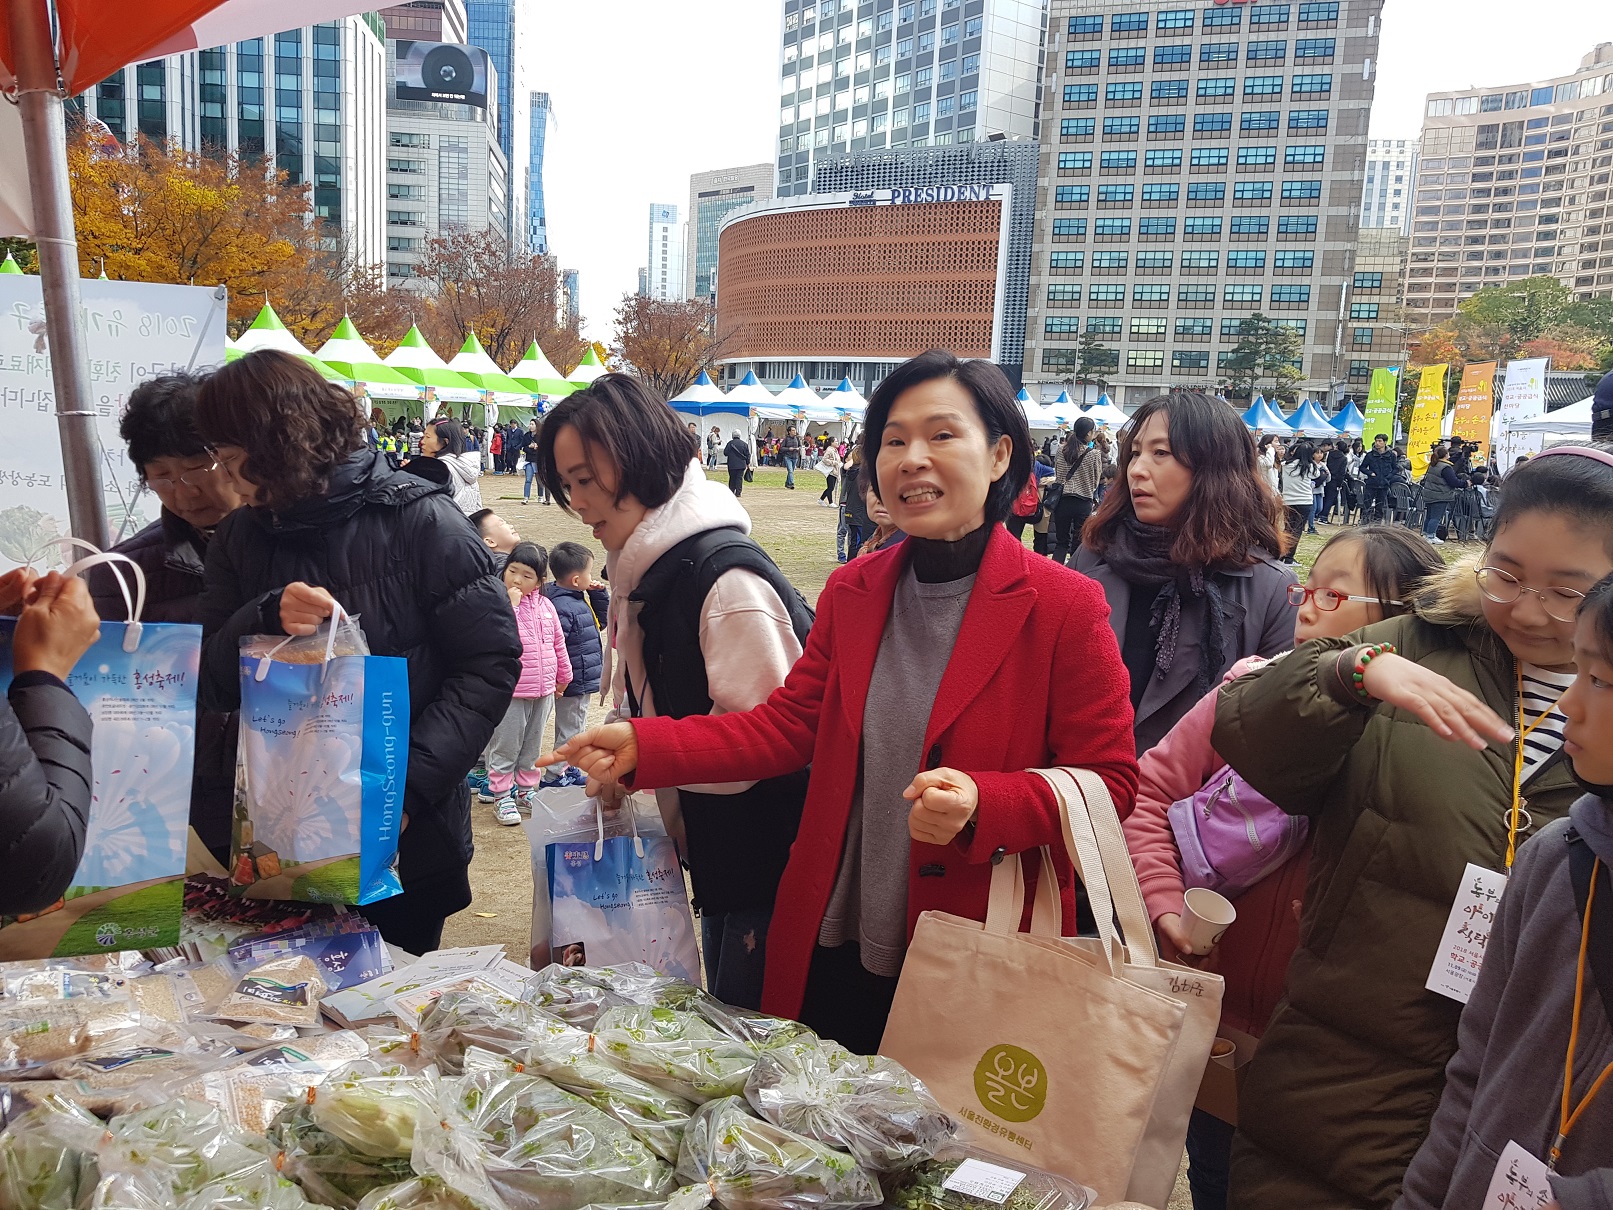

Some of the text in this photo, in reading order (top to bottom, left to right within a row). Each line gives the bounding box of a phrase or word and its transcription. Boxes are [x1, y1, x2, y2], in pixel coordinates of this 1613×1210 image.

[852, 191, 874, 200] Hotel
[890, 184, 994, 205] PRESIDENT
[133, 669, 186, 690] 홍성축제!
[320, 692, 354, 709] 성축제!
[252, 714, 286, 728] Let's go
[378, 691, 397, 842] HongSeong-gun
[592, 892, 610, 901] Let's
[1452, 944, 1468, 954] 2018
[324, 950, 349, 973] 홍성
[957, 1105, 1034, 1152] 서울친환경유통센터
